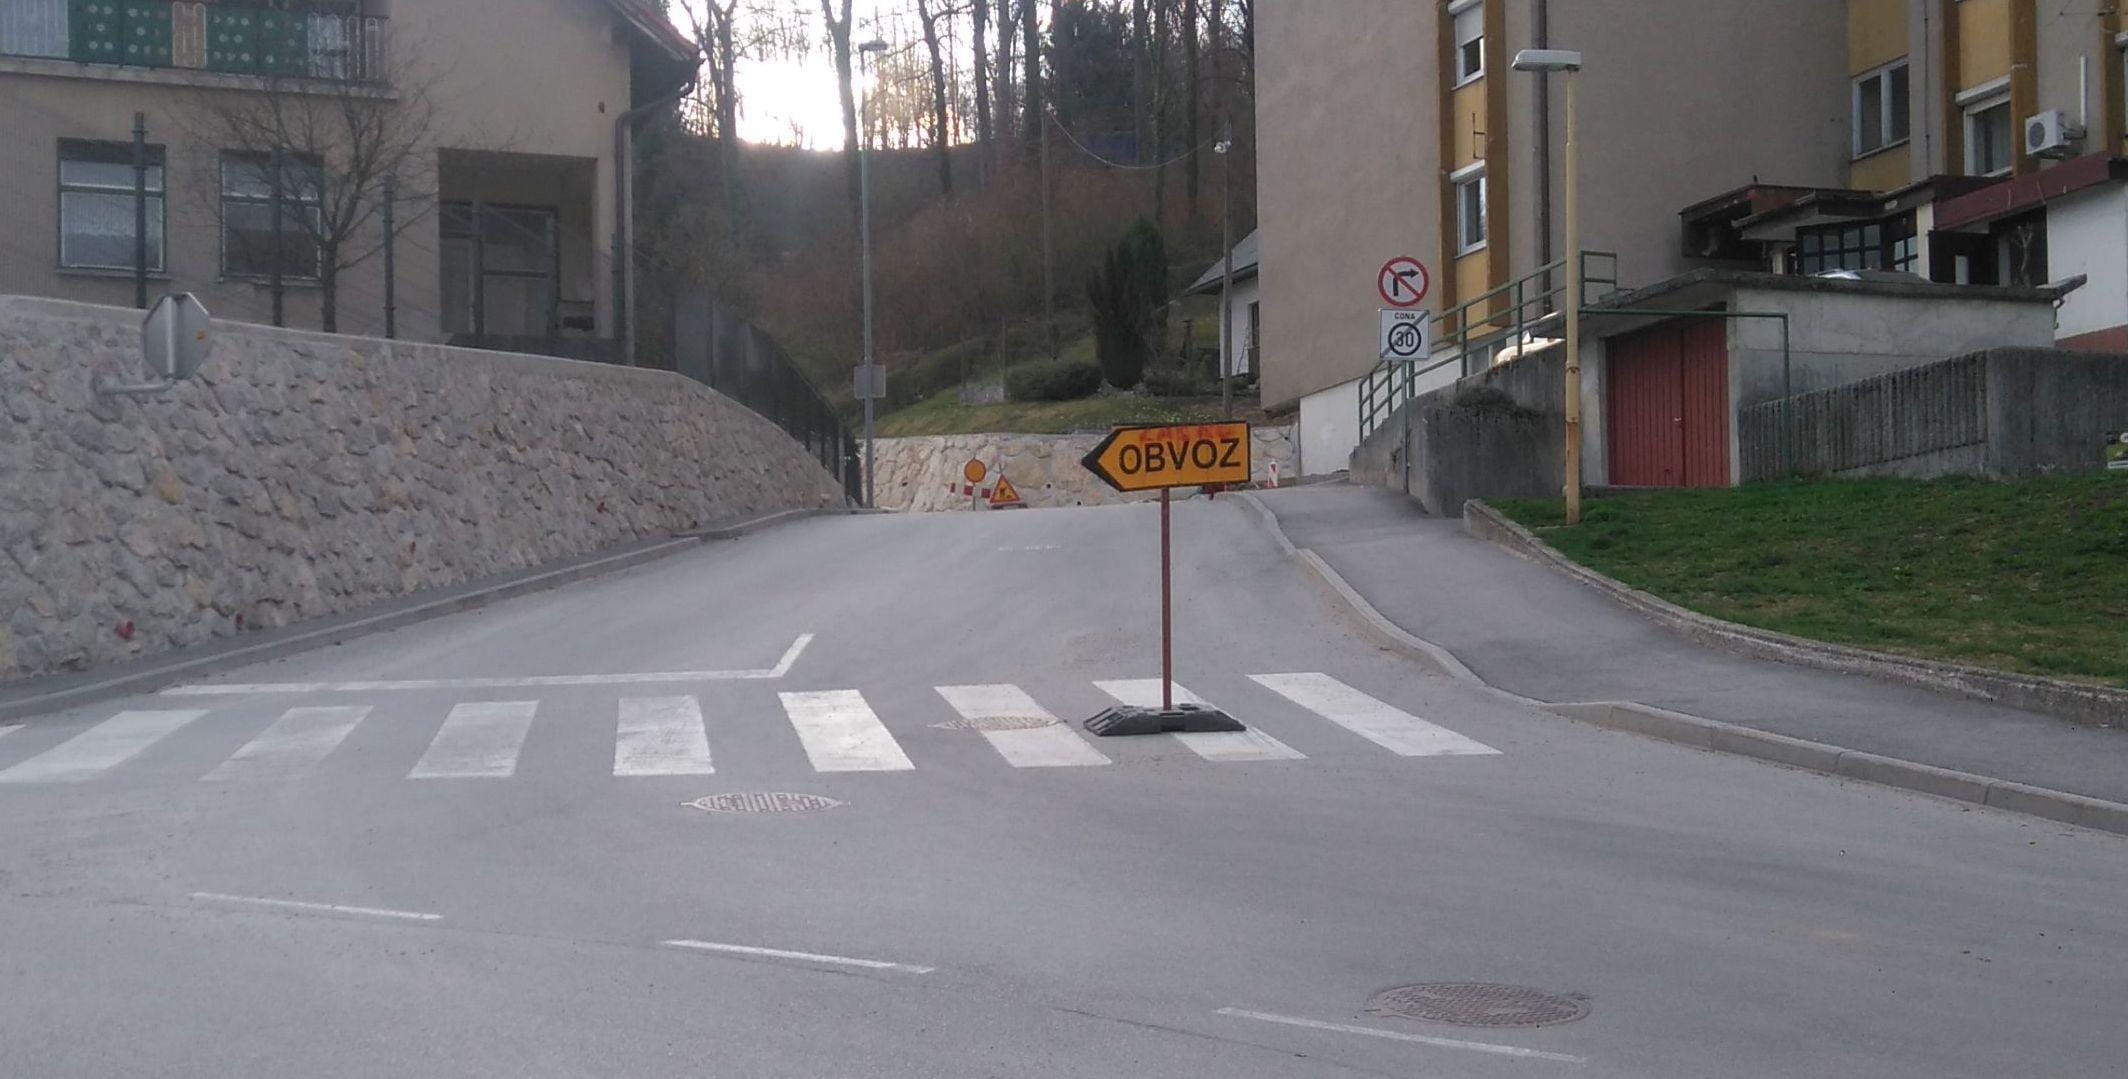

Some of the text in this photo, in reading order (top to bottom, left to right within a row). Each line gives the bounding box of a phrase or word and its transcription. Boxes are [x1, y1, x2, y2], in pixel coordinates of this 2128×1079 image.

[1394, 312, 1415, 320] CONA
[1395, 331, 1414, 347] 30
[1118, 437, 1241, 475] OBVOZ
